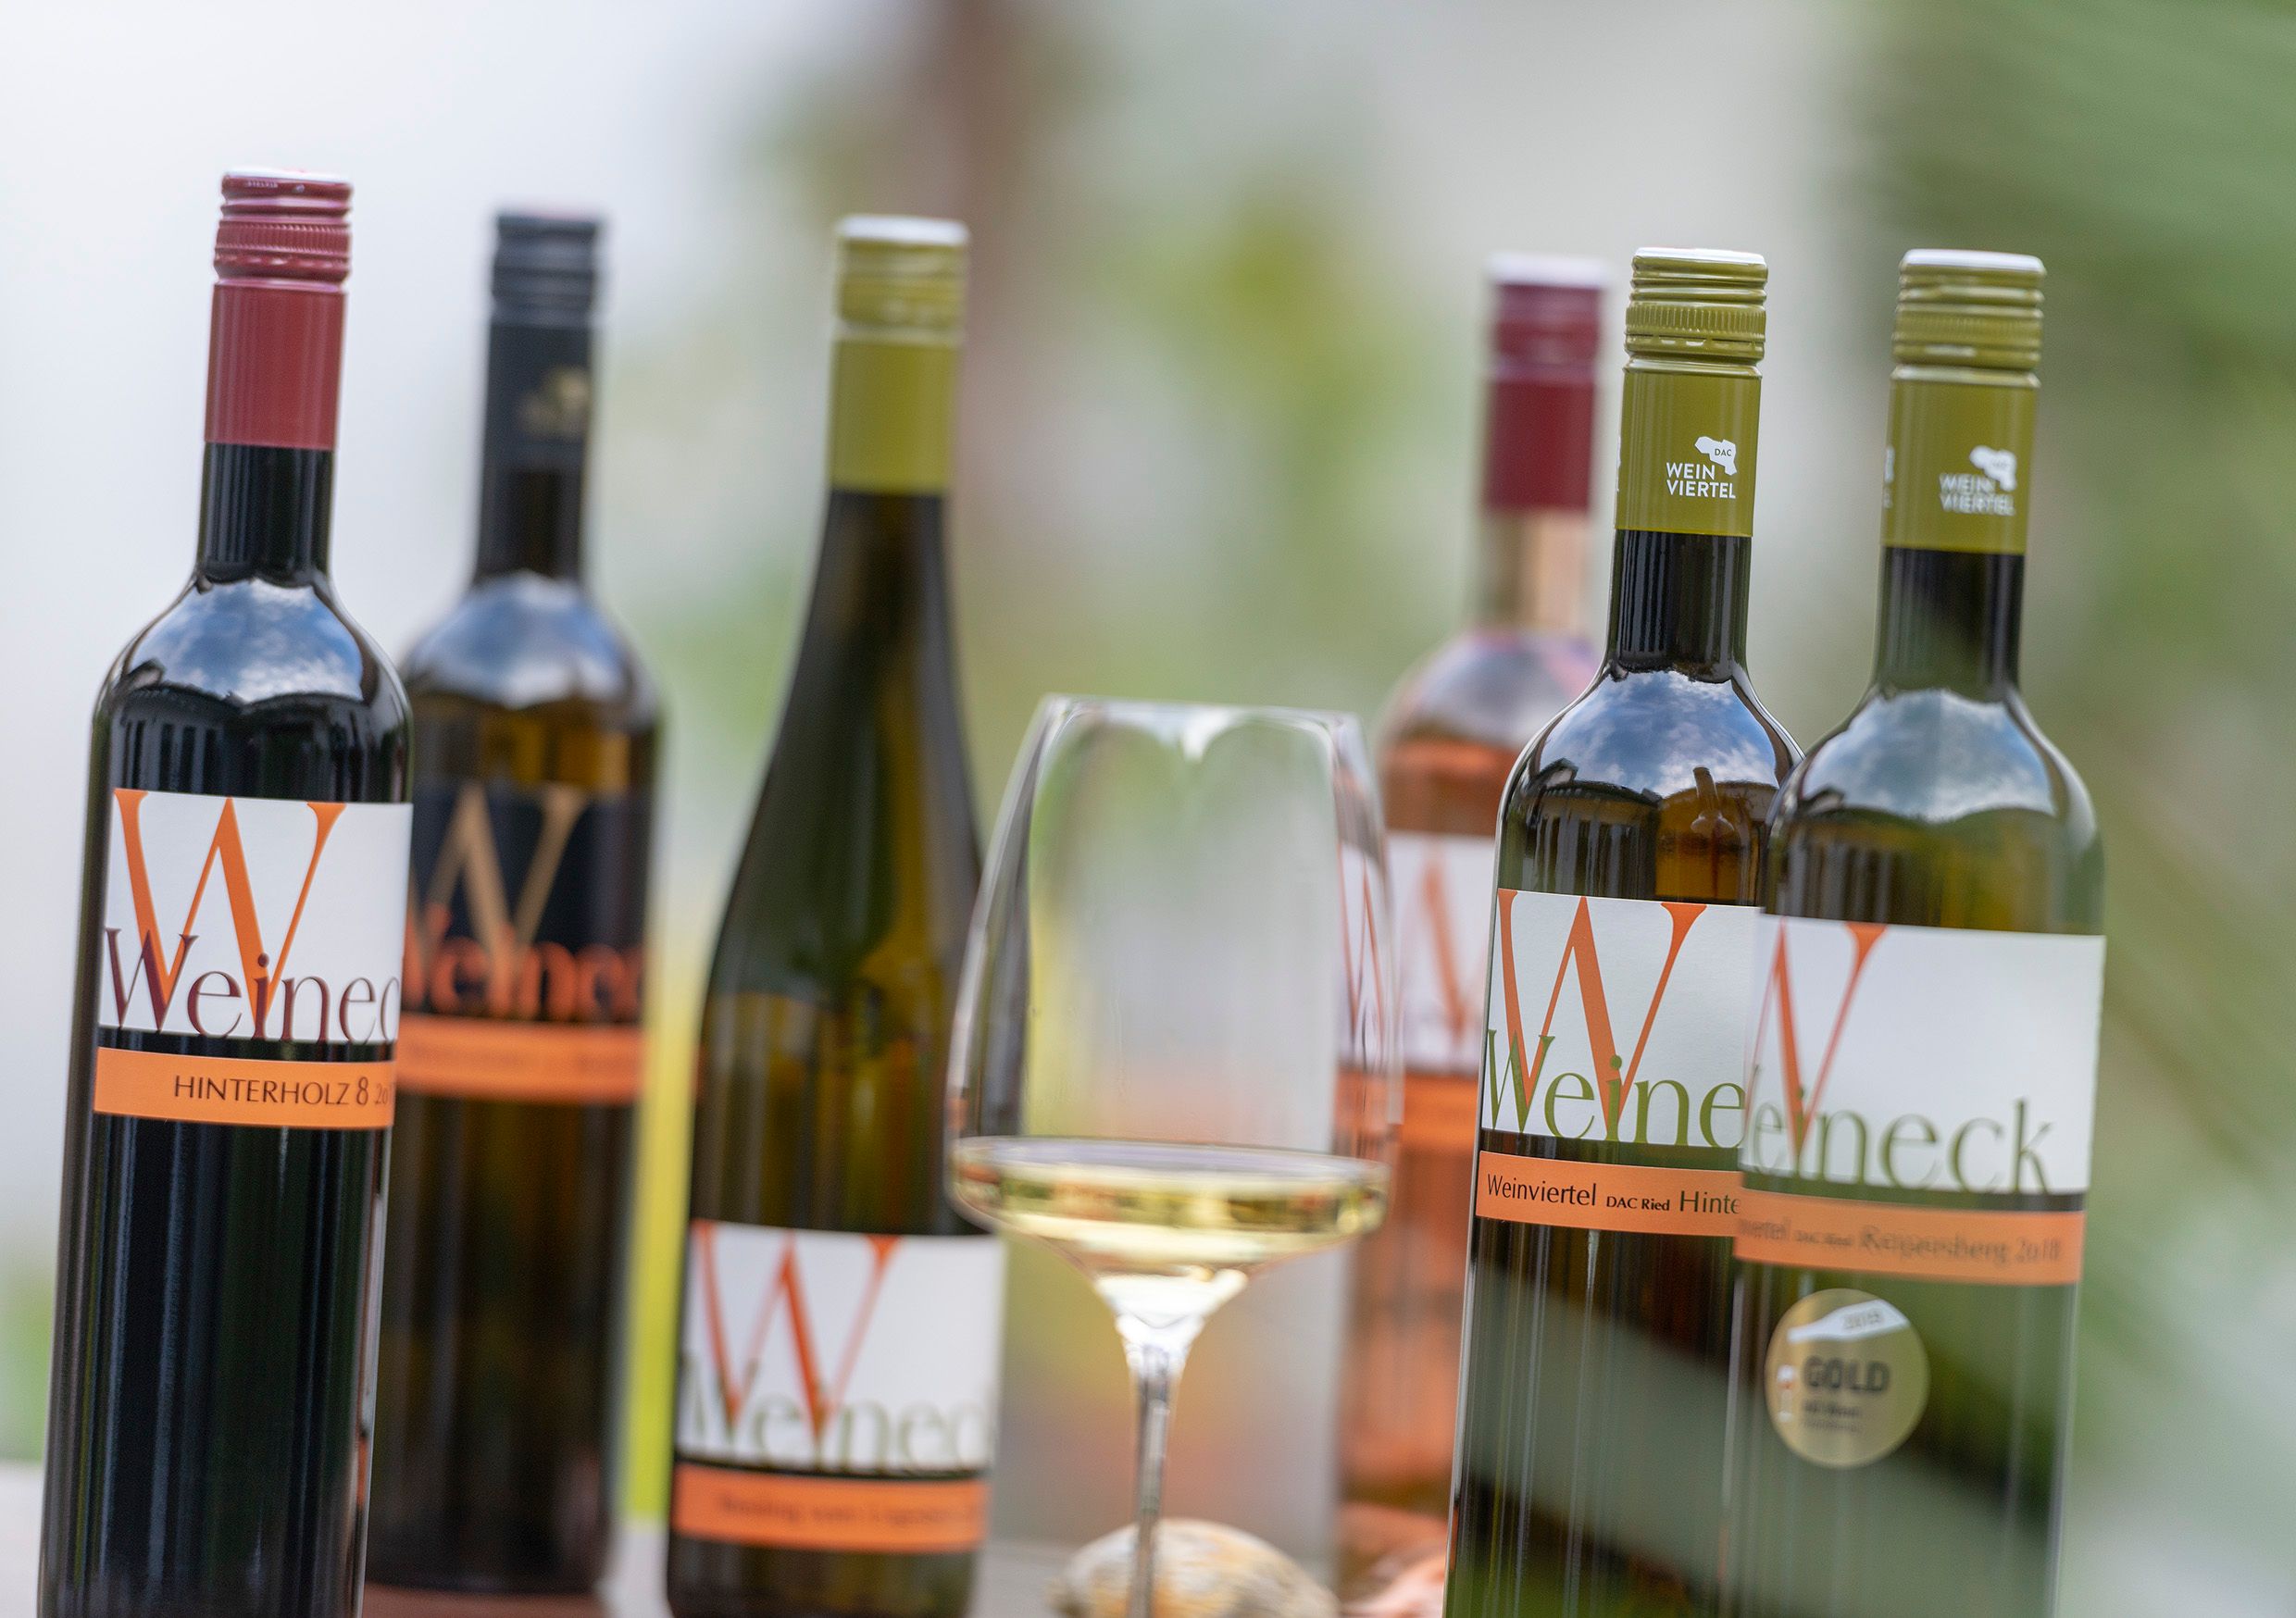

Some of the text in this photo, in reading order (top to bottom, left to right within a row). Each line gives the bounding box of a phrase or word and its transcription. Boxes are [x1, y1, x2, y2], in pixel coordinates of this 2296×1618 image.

[1714, 448, 1732, 456] DAC
[1666, 462, 1716, 480] WEIN
[1666, 479, 1737, 499] VIERTEL
[173, 1074, 350, 1106] HINTERHOLZ
[356, 1077, 370, 1106] 8
[1487, 1173, 1597, 1206] Weinviertel
[1605, 1195, 1638, 1210] DAC
[1641, 1198, 1670, 1212] Ried
[1804, 1355, 1890, 1395] GOLD
